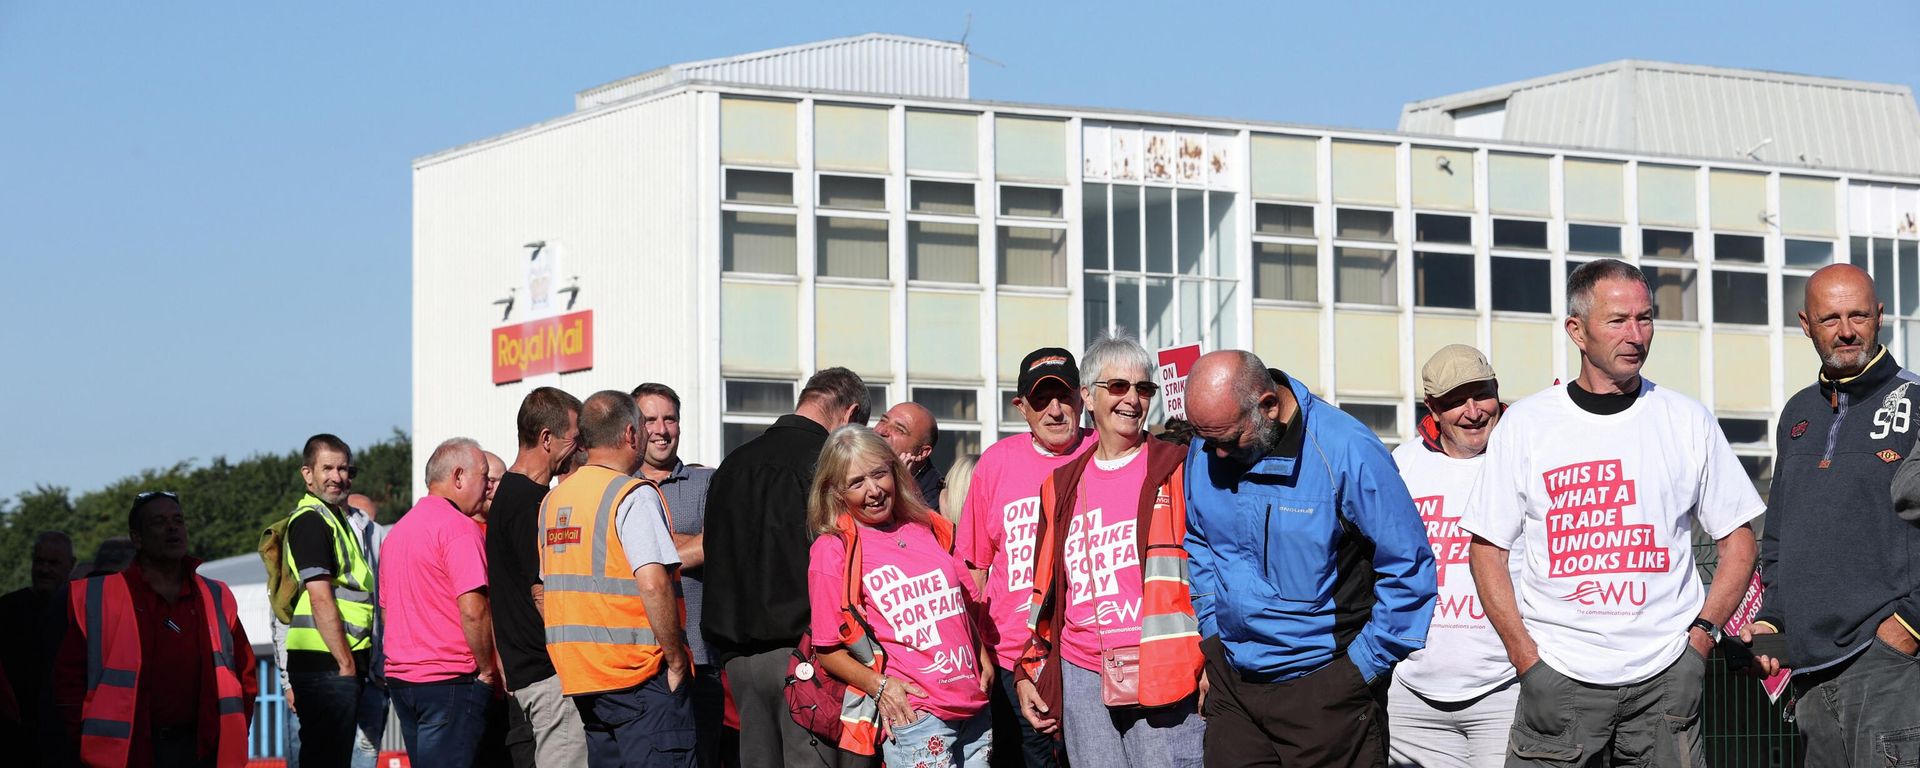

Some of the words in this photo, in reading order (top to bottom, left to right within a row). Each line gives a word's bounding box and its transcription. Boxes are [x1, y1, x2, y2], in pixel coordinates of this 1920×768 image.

[498, 327, 544, 370] Royal
[547, 319, 583, 359] Mail
[1163, 366, 1174, 381] ON
[1165, 380, 1185, 397] STRIK
[1168, 398, 1182, 412] FOR
[1548, 465, 1591, 491] THIS
[1597, 463, 1616, 482] IS
[1550, 486, 1610, 511] WHAT
[1614, 484, 1629, 503] A
[1006, 501, 1035, 522] ON
[1550, 508, 1617, 532] TRADE
[1008, 522, 1037, 544] STR
[1070, 514, 1096, 536] ON
[1067, 524, 1134, 558] STRIKE
[1448, 543, 1470, 559] FA
[1551, 528, 1652, 554] UNIONIST
[1011, 545, 1032, 565] FO
[1070, 552, 1107, 579] FOR
[1112, 544, 1137, 566] FA
[1552, 552, 1620, 575] LOOKS
[1627, 551, 1665, 569] LIKE
[869, 567, 899, 591] ON
[1011, 566, 1033, 587] PA
[1072, 574, 1111, 600] PAY
[880, 574, 943, 613] STRIKE
[1729, 620, 1735, 630] I
[1735, 579, 1760, 626] SUPPORT
[892, 606, 926, 632] FOR
[929, 591, 964, 617] FAIR
[1078, 597, 1142, 625] CW
[1432, 594, 1487, 620] WU
